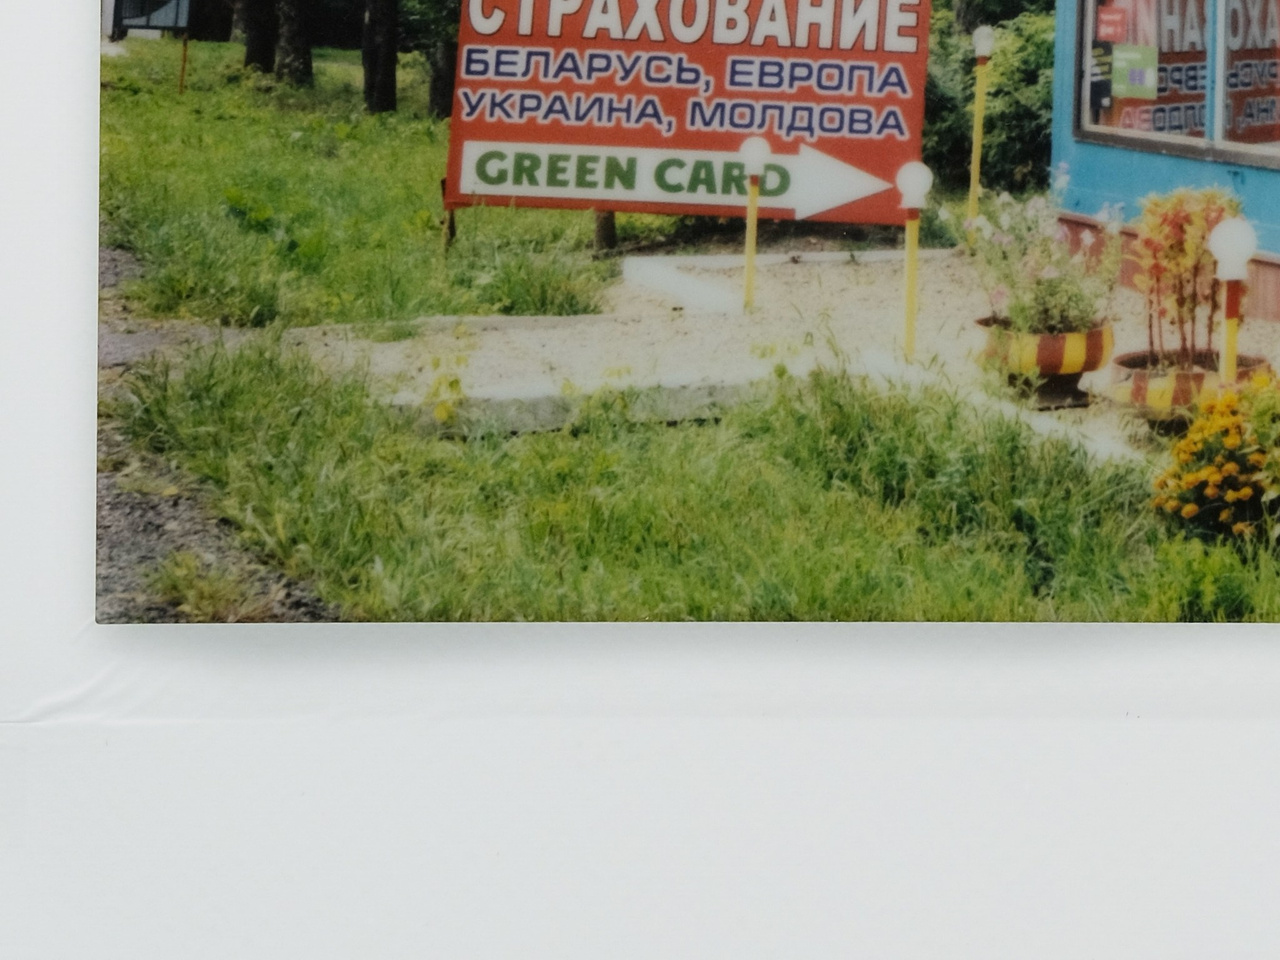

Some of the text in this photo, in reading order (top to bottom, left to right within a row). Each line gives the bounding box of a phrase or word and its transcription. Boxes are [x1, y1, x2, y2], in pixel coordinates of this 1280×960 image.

[463, 47, 909, 95] БЕЛАРУСЬ, ЕВРОПА
[461, 90, 907, 138] УКРАИНА, МОЛДОВА
[475, 150, 791, 197] GREEN CARD
